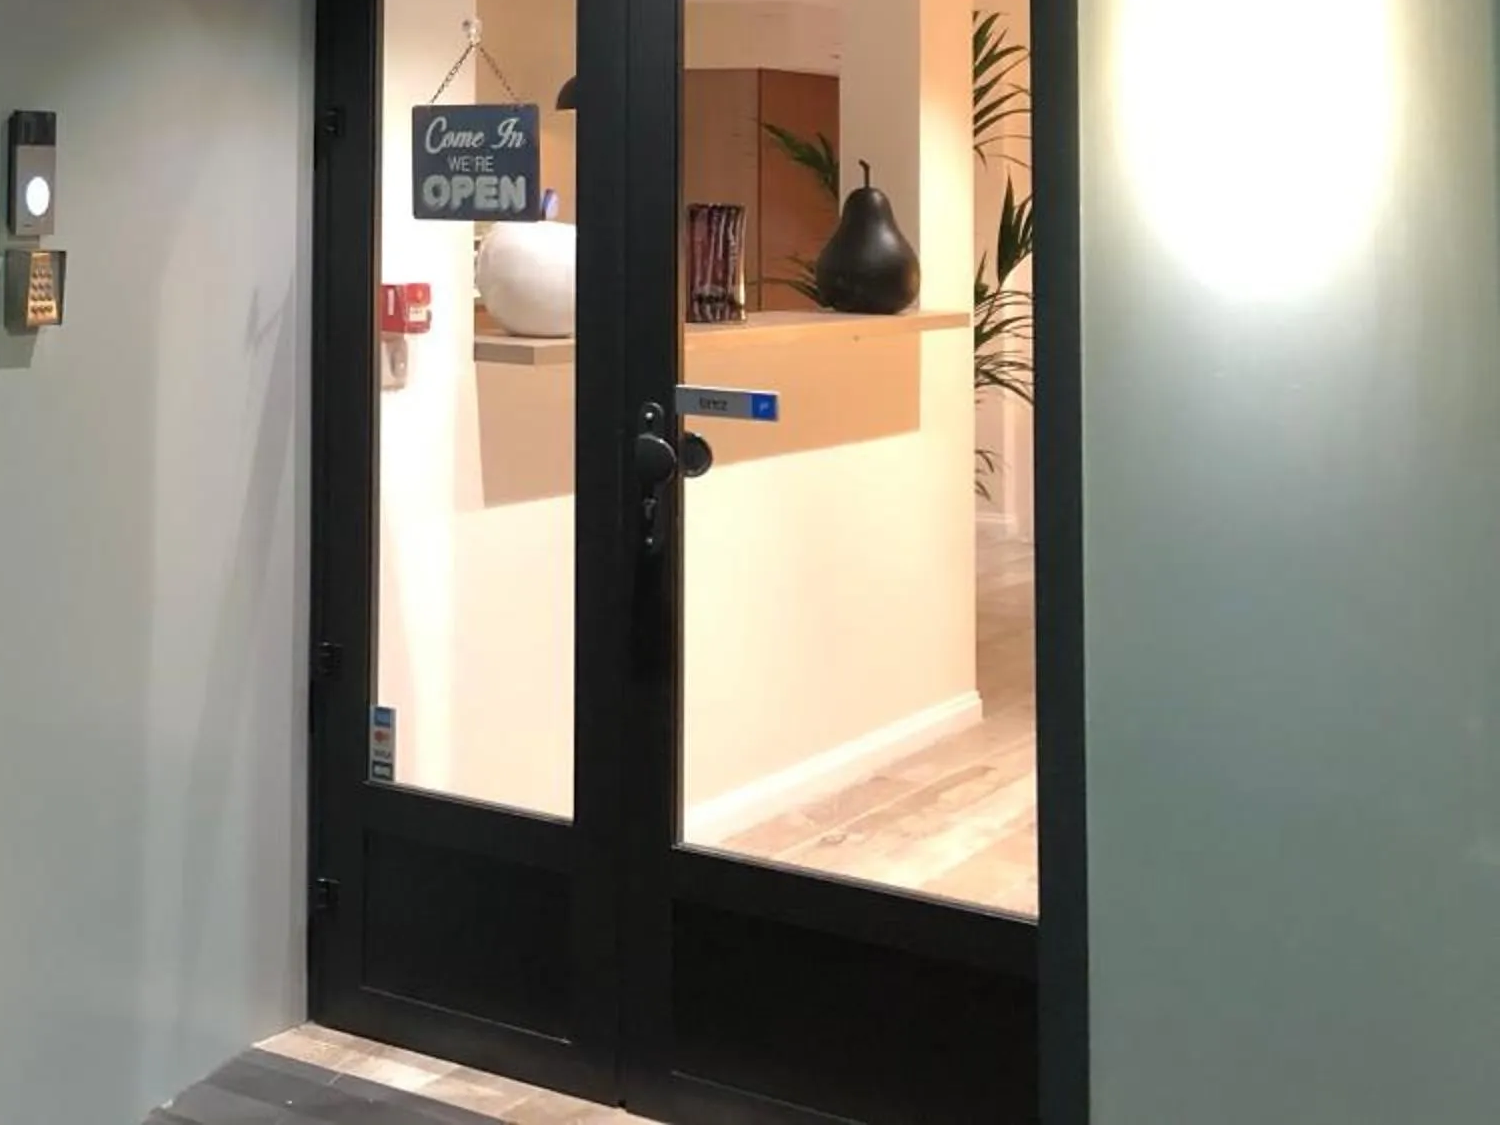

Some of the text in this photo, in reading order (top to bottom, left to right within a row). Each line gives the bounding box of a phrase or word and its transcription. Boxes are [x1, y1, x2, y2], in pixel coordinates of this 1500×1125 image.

[425, 116, 526, 154] Come In
[423, 174, 526, 213] OPEN
